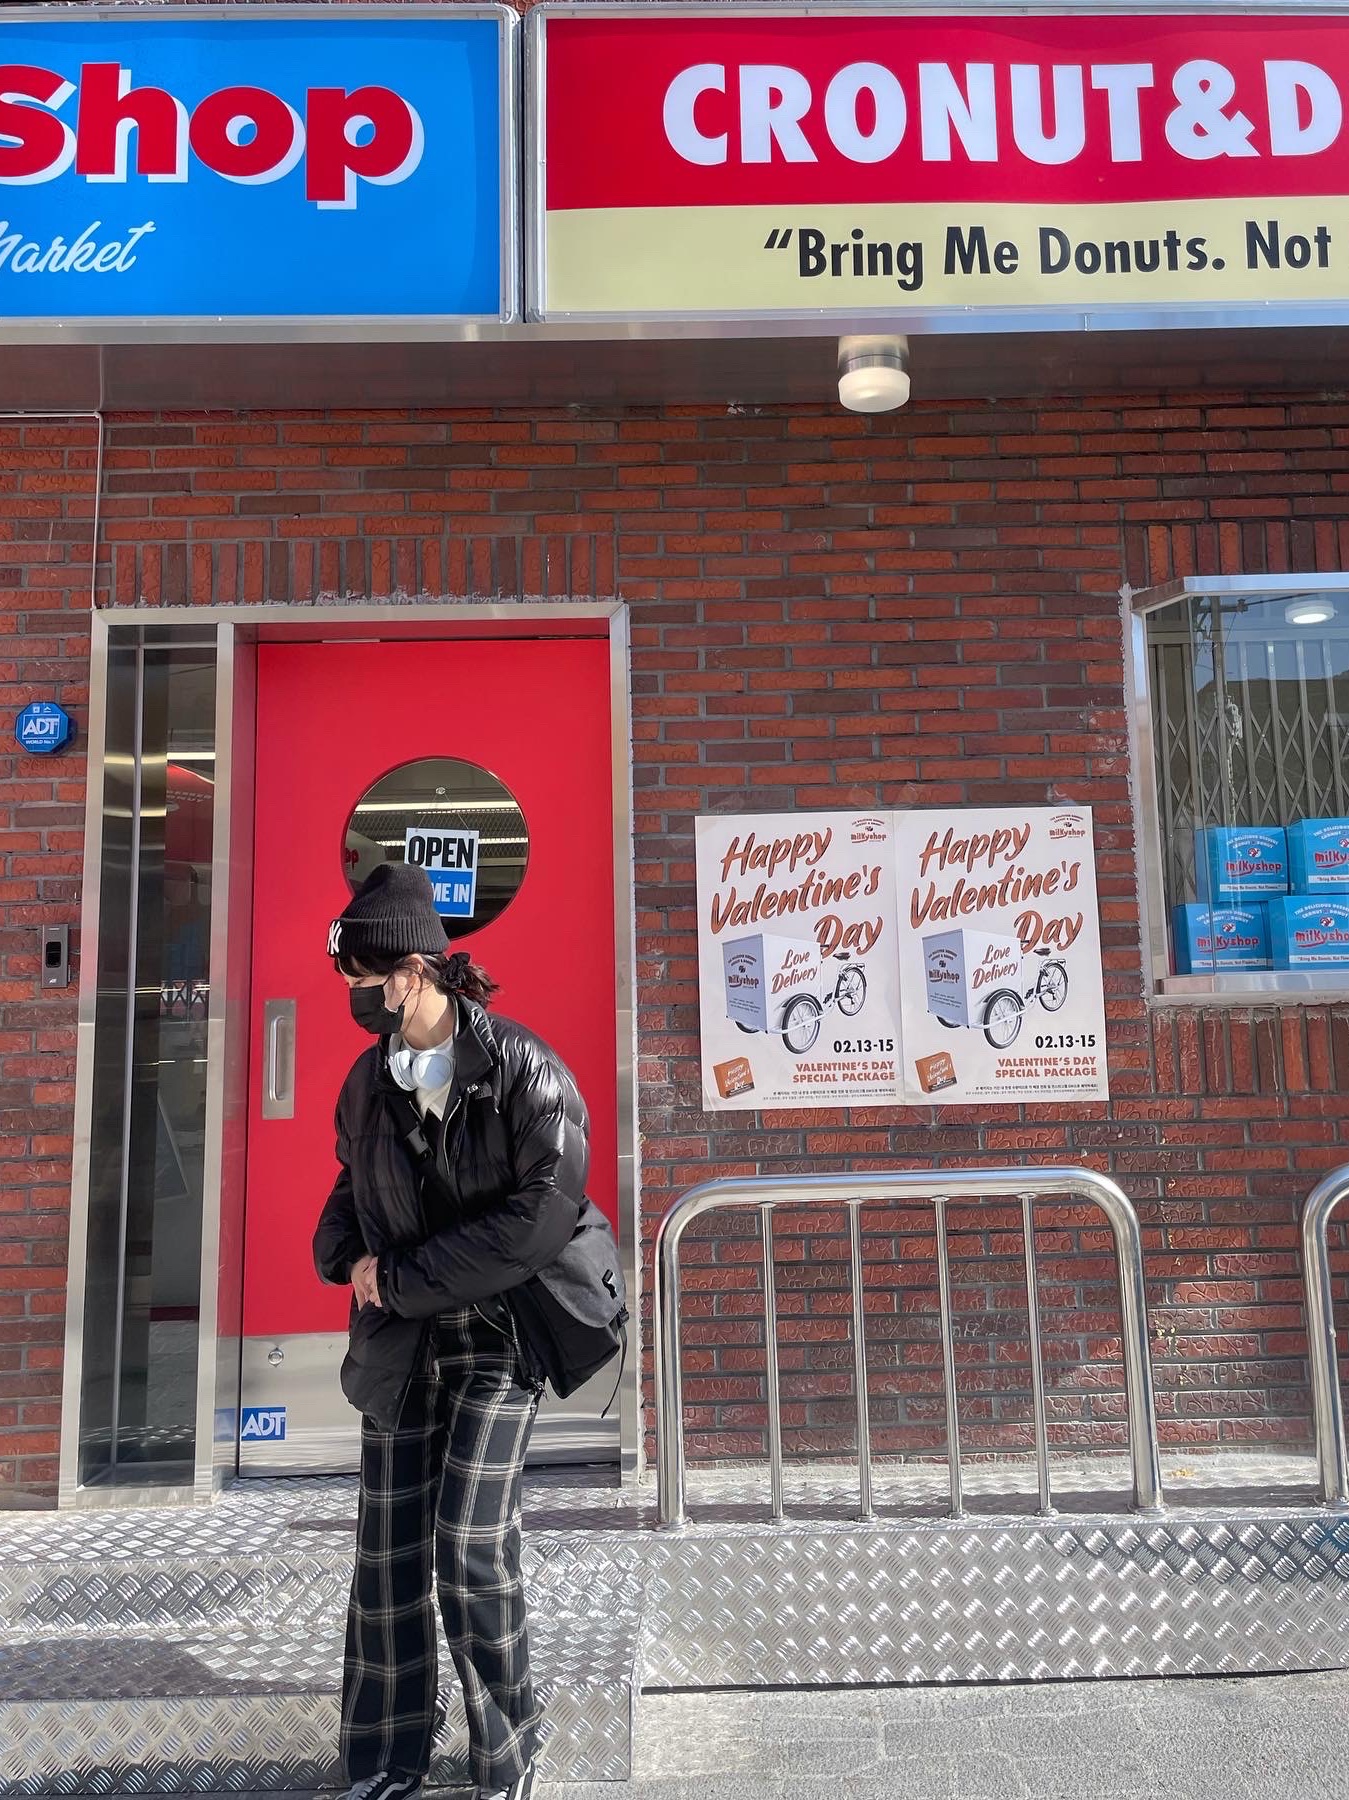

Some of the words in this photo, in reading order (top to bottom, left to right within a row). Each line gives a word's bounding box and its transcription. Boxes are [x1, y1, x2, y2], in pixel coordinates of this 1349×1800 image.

[662, 58, 1343, 165] CRONUT&D
[943, 226, 1019, 275] Me
[1038, 227, 1225, 275] Donuts.
[1245, 220, 1332, 270] Not
[23, 717, 59, 735] ADT
[407, 835, 475, 868] OPEN
[720, 827, 833, 882] Happy
[919, 822, 1031, 878] Happy
[453, 883, 471, 903] IN
[710, 864, 882, 934] Valentine's
[909, 860, 1081, 930] Valentine's
[813, 914, 884, 959] Day
[1013, 910, 1084, 955] Day
[780, 949, 811, 970] Love
[982, 944, 1011, 966] Love
[771, 965, 818, 994] Delivery
[971, 961, 1018, 989] Delivery
[833, 1039, 894, 1053] 02.13-15
[1035, 1035, 1096, 1048] 02.13-15
[795, 1061, 868, 1072] VALENTINE'S
[871, 1060, 895, 1071] DAY
[995, 1069, 1040, 1079] SPECIAL
[1044, 1067, 1097, 1078] PACKAGE
[997, 1056, 1070, 1068] VALENTINE'S
[1073, 1056, 1097, 1066] DAY
[792, 1073, 838, 1083] SPECIAL
[842, 1071, 896, 1082] PACKAGE
[241, 1412, 286, 1437] ADT
